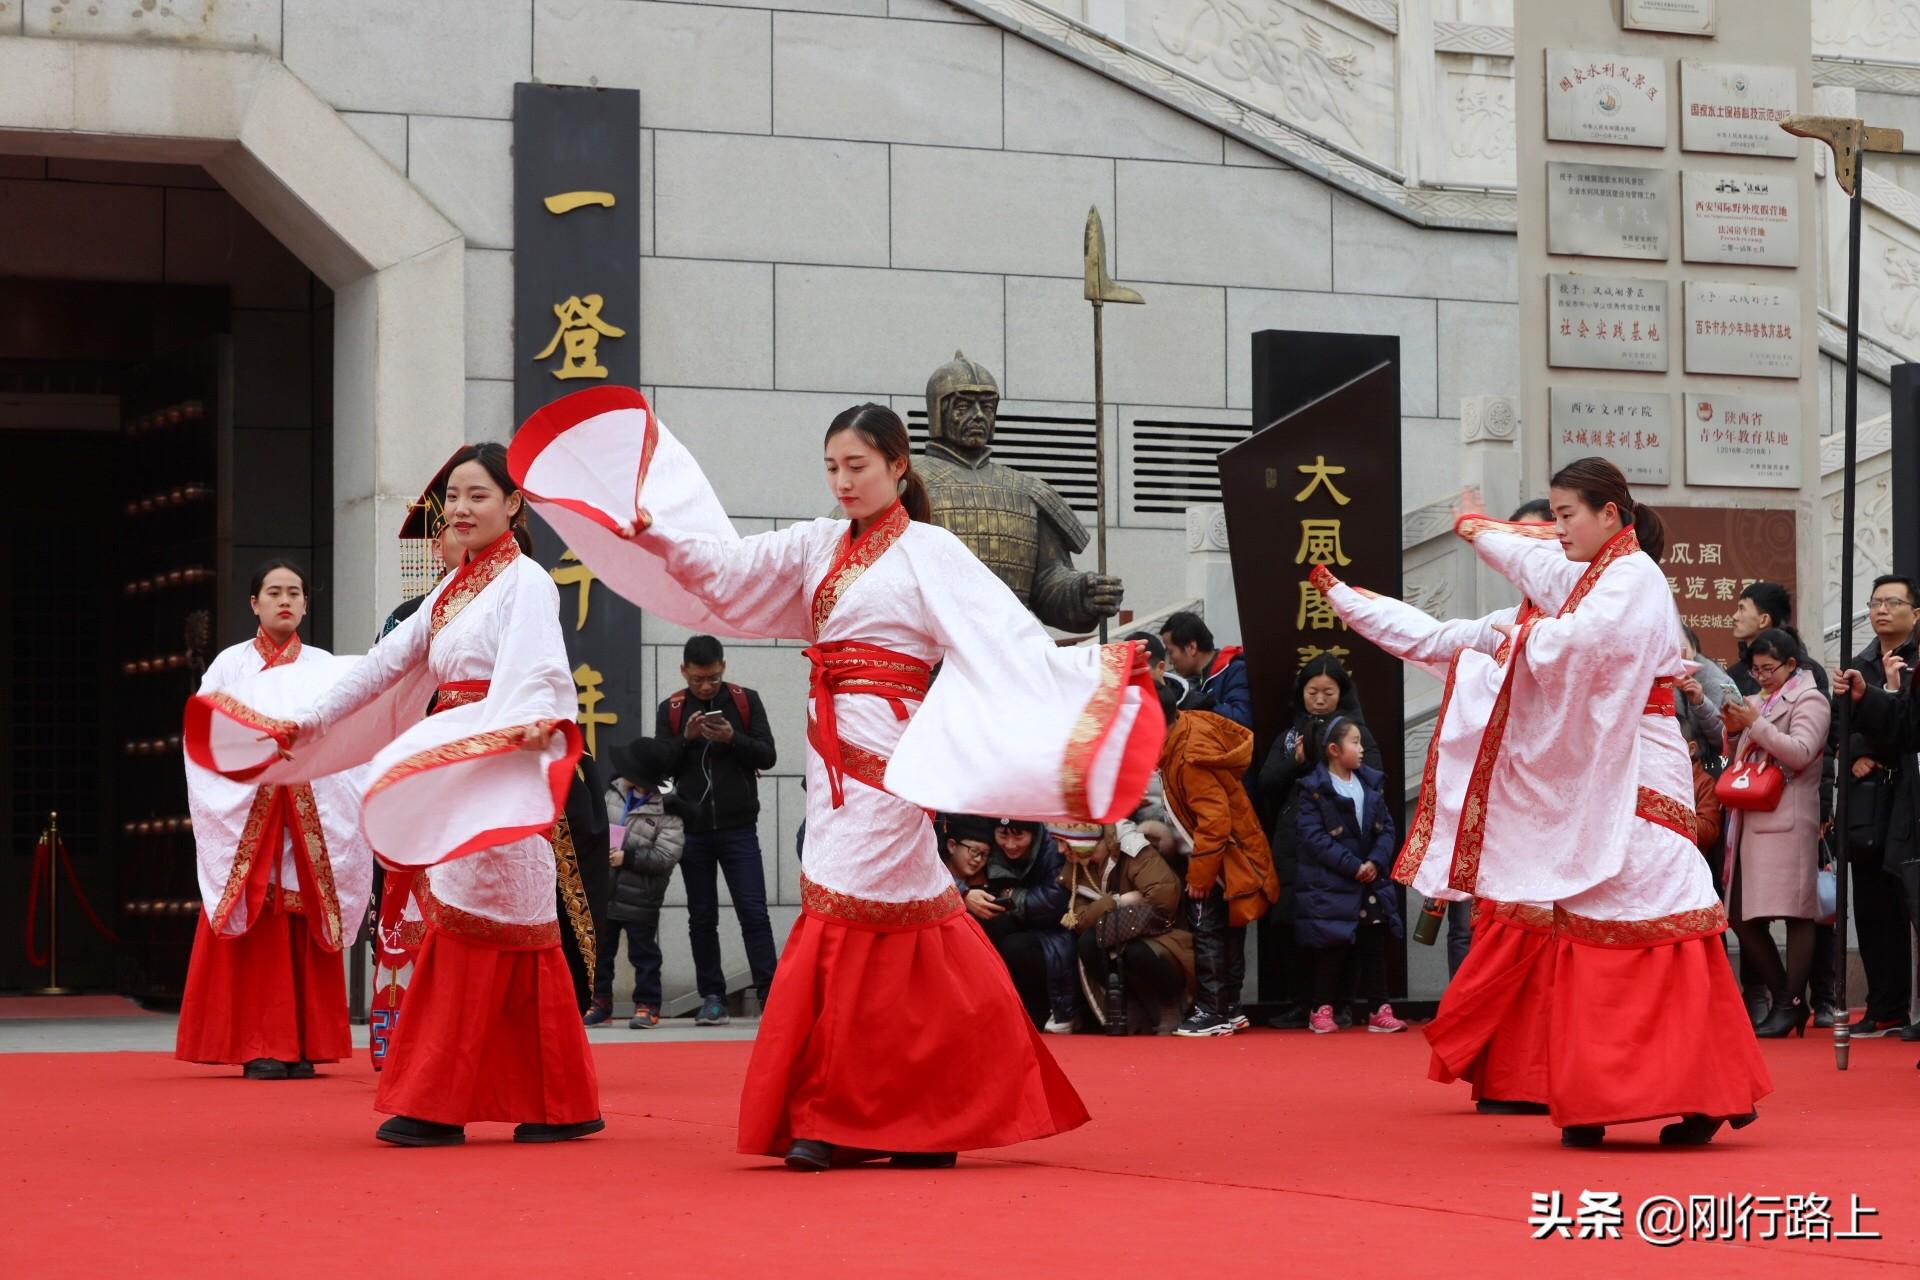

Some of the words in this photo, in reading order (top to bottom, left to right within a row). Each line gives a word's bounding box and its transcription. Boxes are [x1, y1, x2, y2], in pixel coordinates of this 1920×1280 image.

[1560, 63, 1658, 101] 国家水利风景区
[1695, 201, 1788, 217] 西安国际野外度假营地
[1559, 317, 1660, 342] 社会实践基地
[1571, 402, 1653, 417] 西安文理学院
[1724, 411, 1763, 426] 陕西省
[1562, 428, 1660, 450] 汉城湖实训基地
[1700, 428, 1789, 446] 青少年教育基地
[1659, 543, 1721, 565] 风阁
